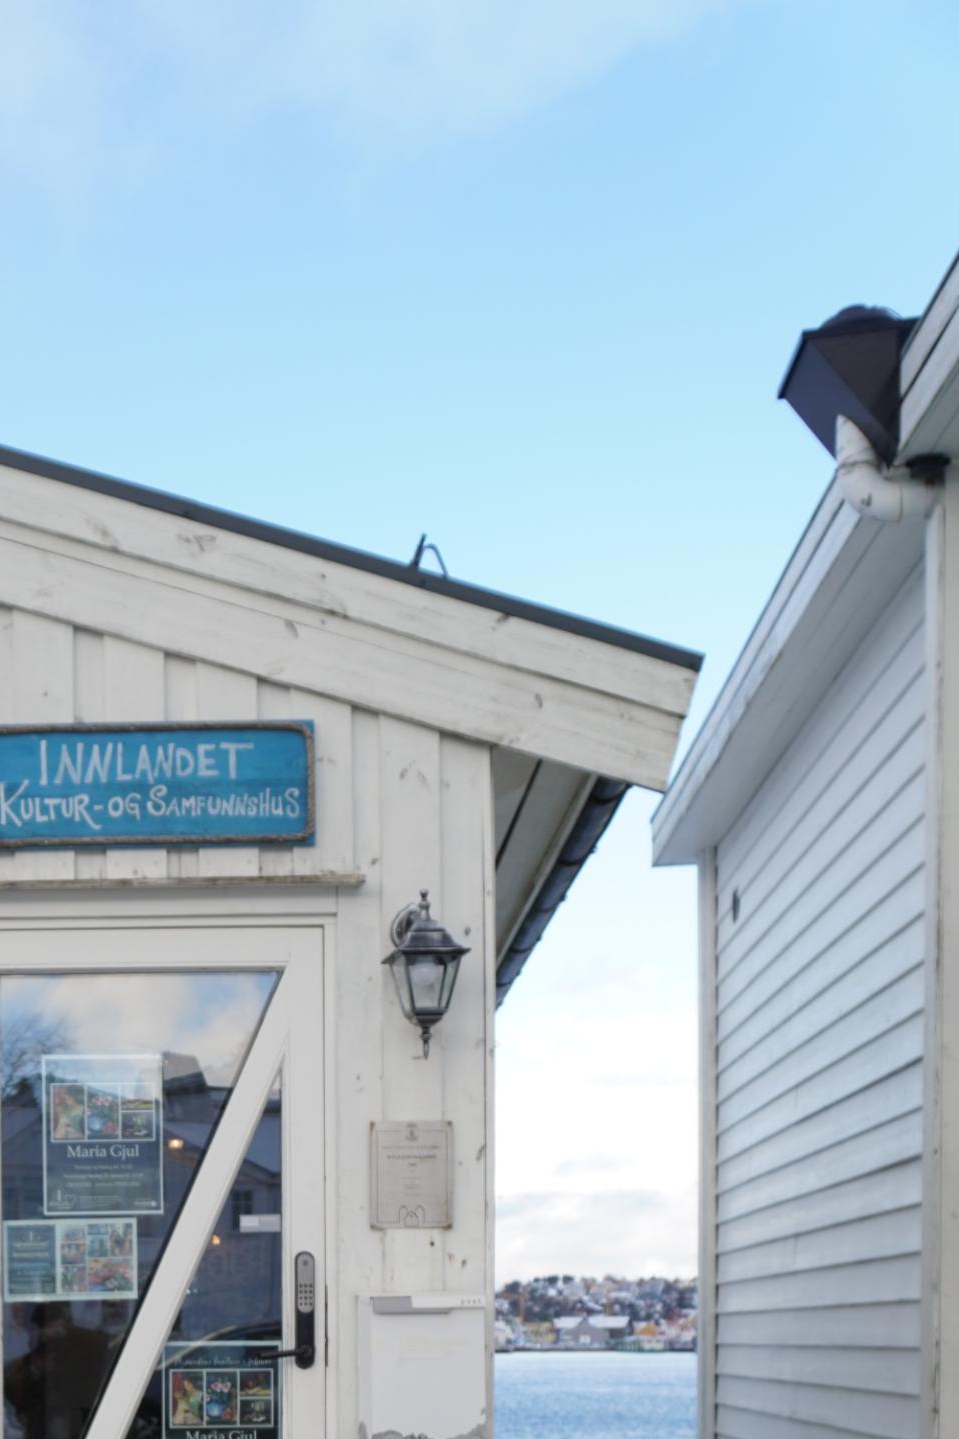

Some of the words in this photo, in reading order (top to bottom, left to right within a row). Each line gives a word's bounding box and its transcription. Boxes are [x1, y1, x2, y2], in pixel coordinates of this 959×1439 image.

[38, 739, 254, 785] INNLANDET
[67, 1145, 107, 1158] Maria
[110, 1144, 139, 1160] Gjul
